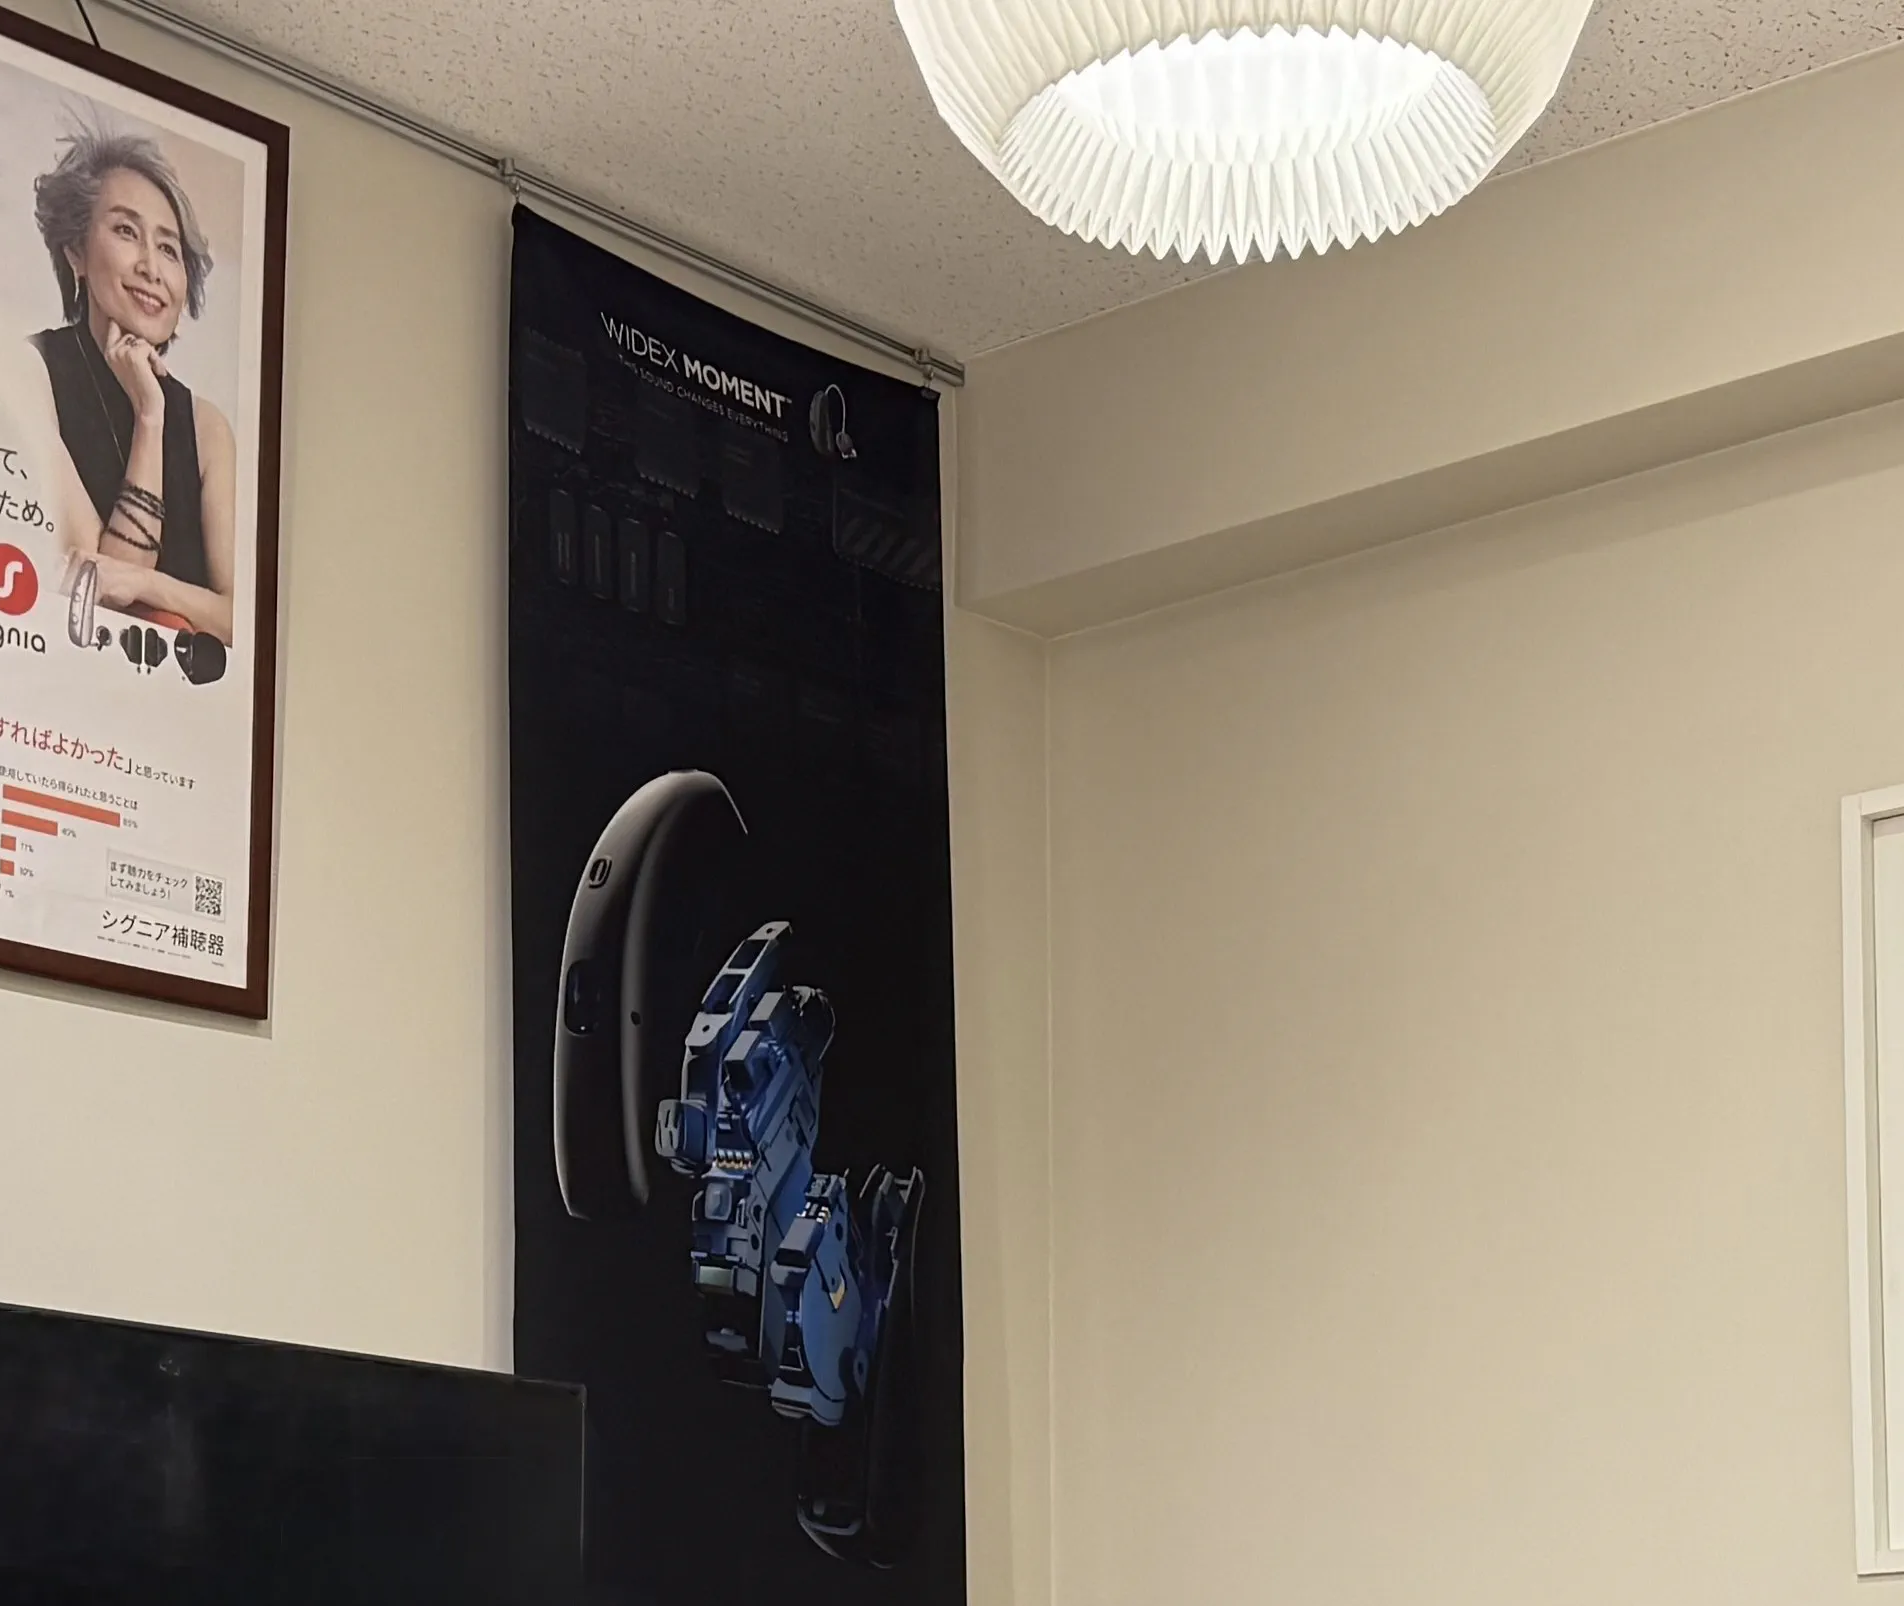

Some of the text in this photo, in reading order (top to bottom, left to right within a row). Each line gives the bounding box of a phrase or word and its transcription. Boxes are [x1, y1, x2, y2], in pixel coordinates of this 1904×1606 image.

[600, 311, 786, 419] WIDEX MOMENT
[102, 910, 224, 957] シグニア補聴器
